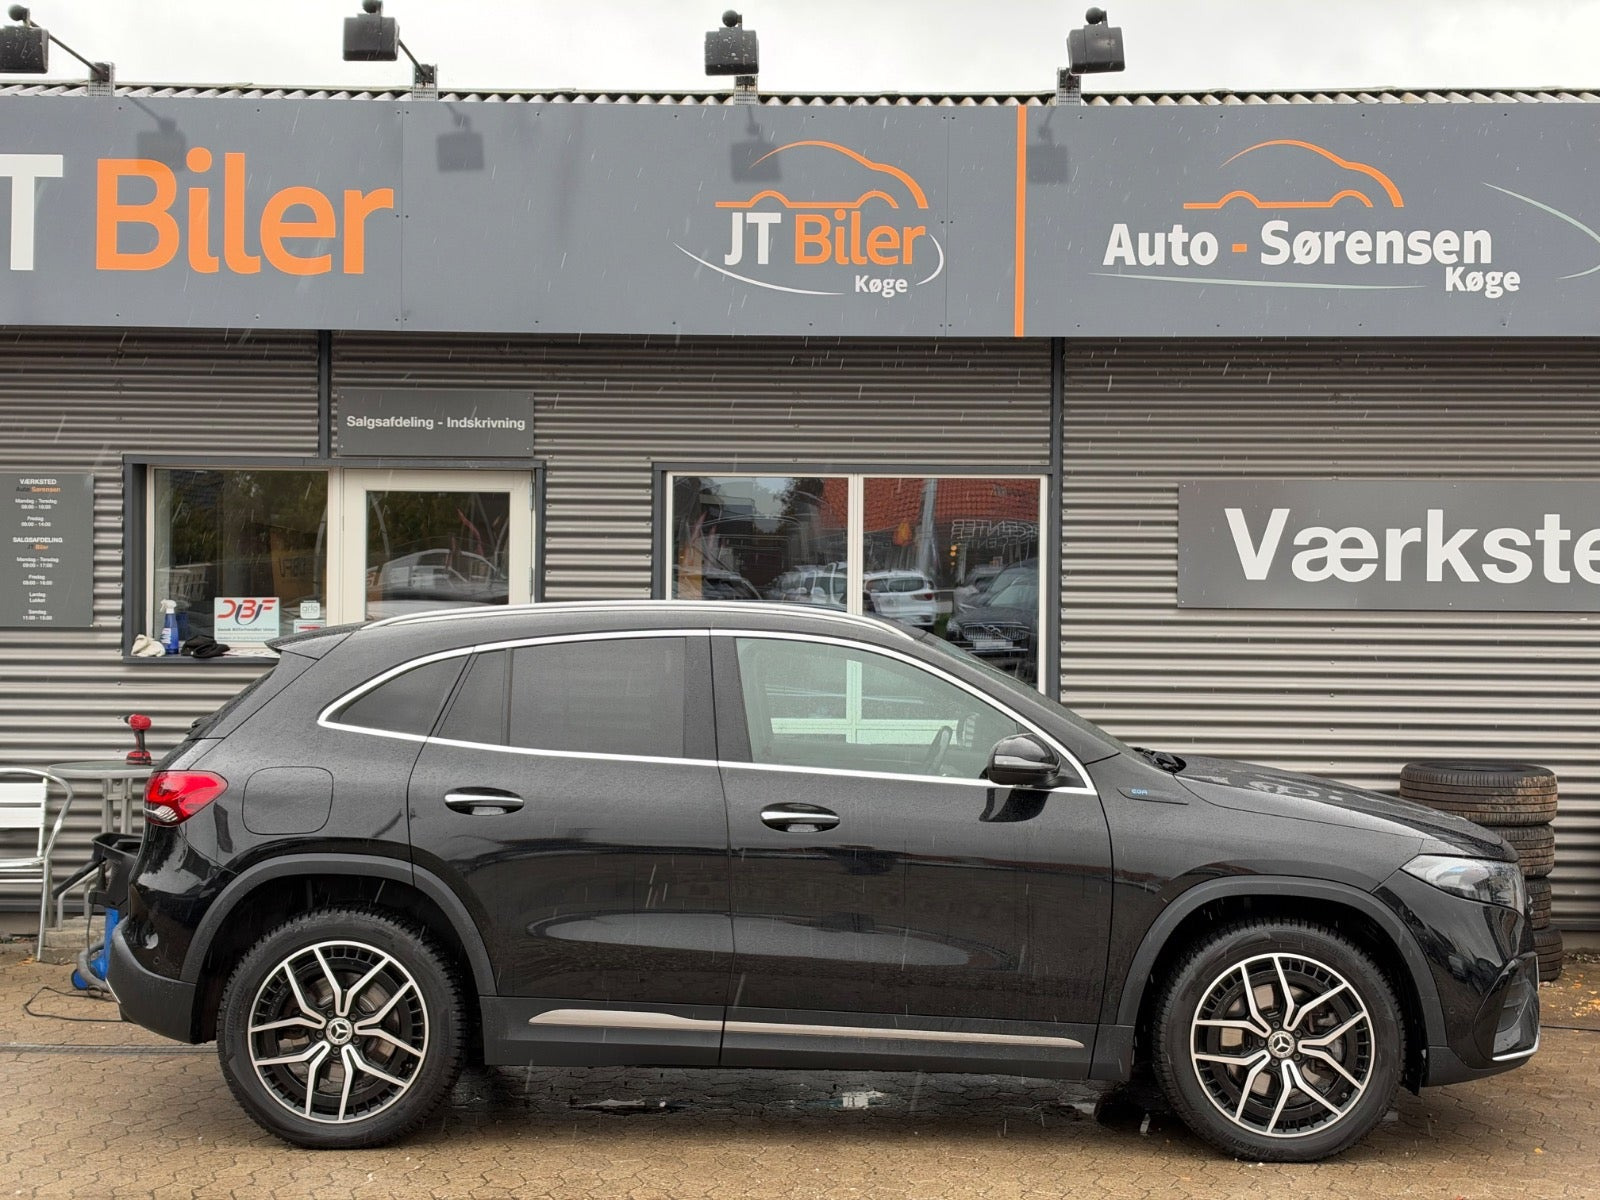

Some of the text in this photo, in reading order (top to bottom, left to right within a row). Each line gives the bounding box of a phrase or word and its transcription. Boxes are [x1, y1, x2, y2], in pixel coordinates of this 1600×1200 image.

[96, 147, 394, 275] Biler
[724, 208, 926, 266] JT Biler
[1103, 223, 1219, 266] Auto
[1260, 220, 1492, 266] Sørensen
[855, 275, 908, 298] Køge
[1445, 266, 1521, 298] Køge
[346, 415, 434, 430] Salgsafdeling
[447, 416, 526, 431] Indskrivning
